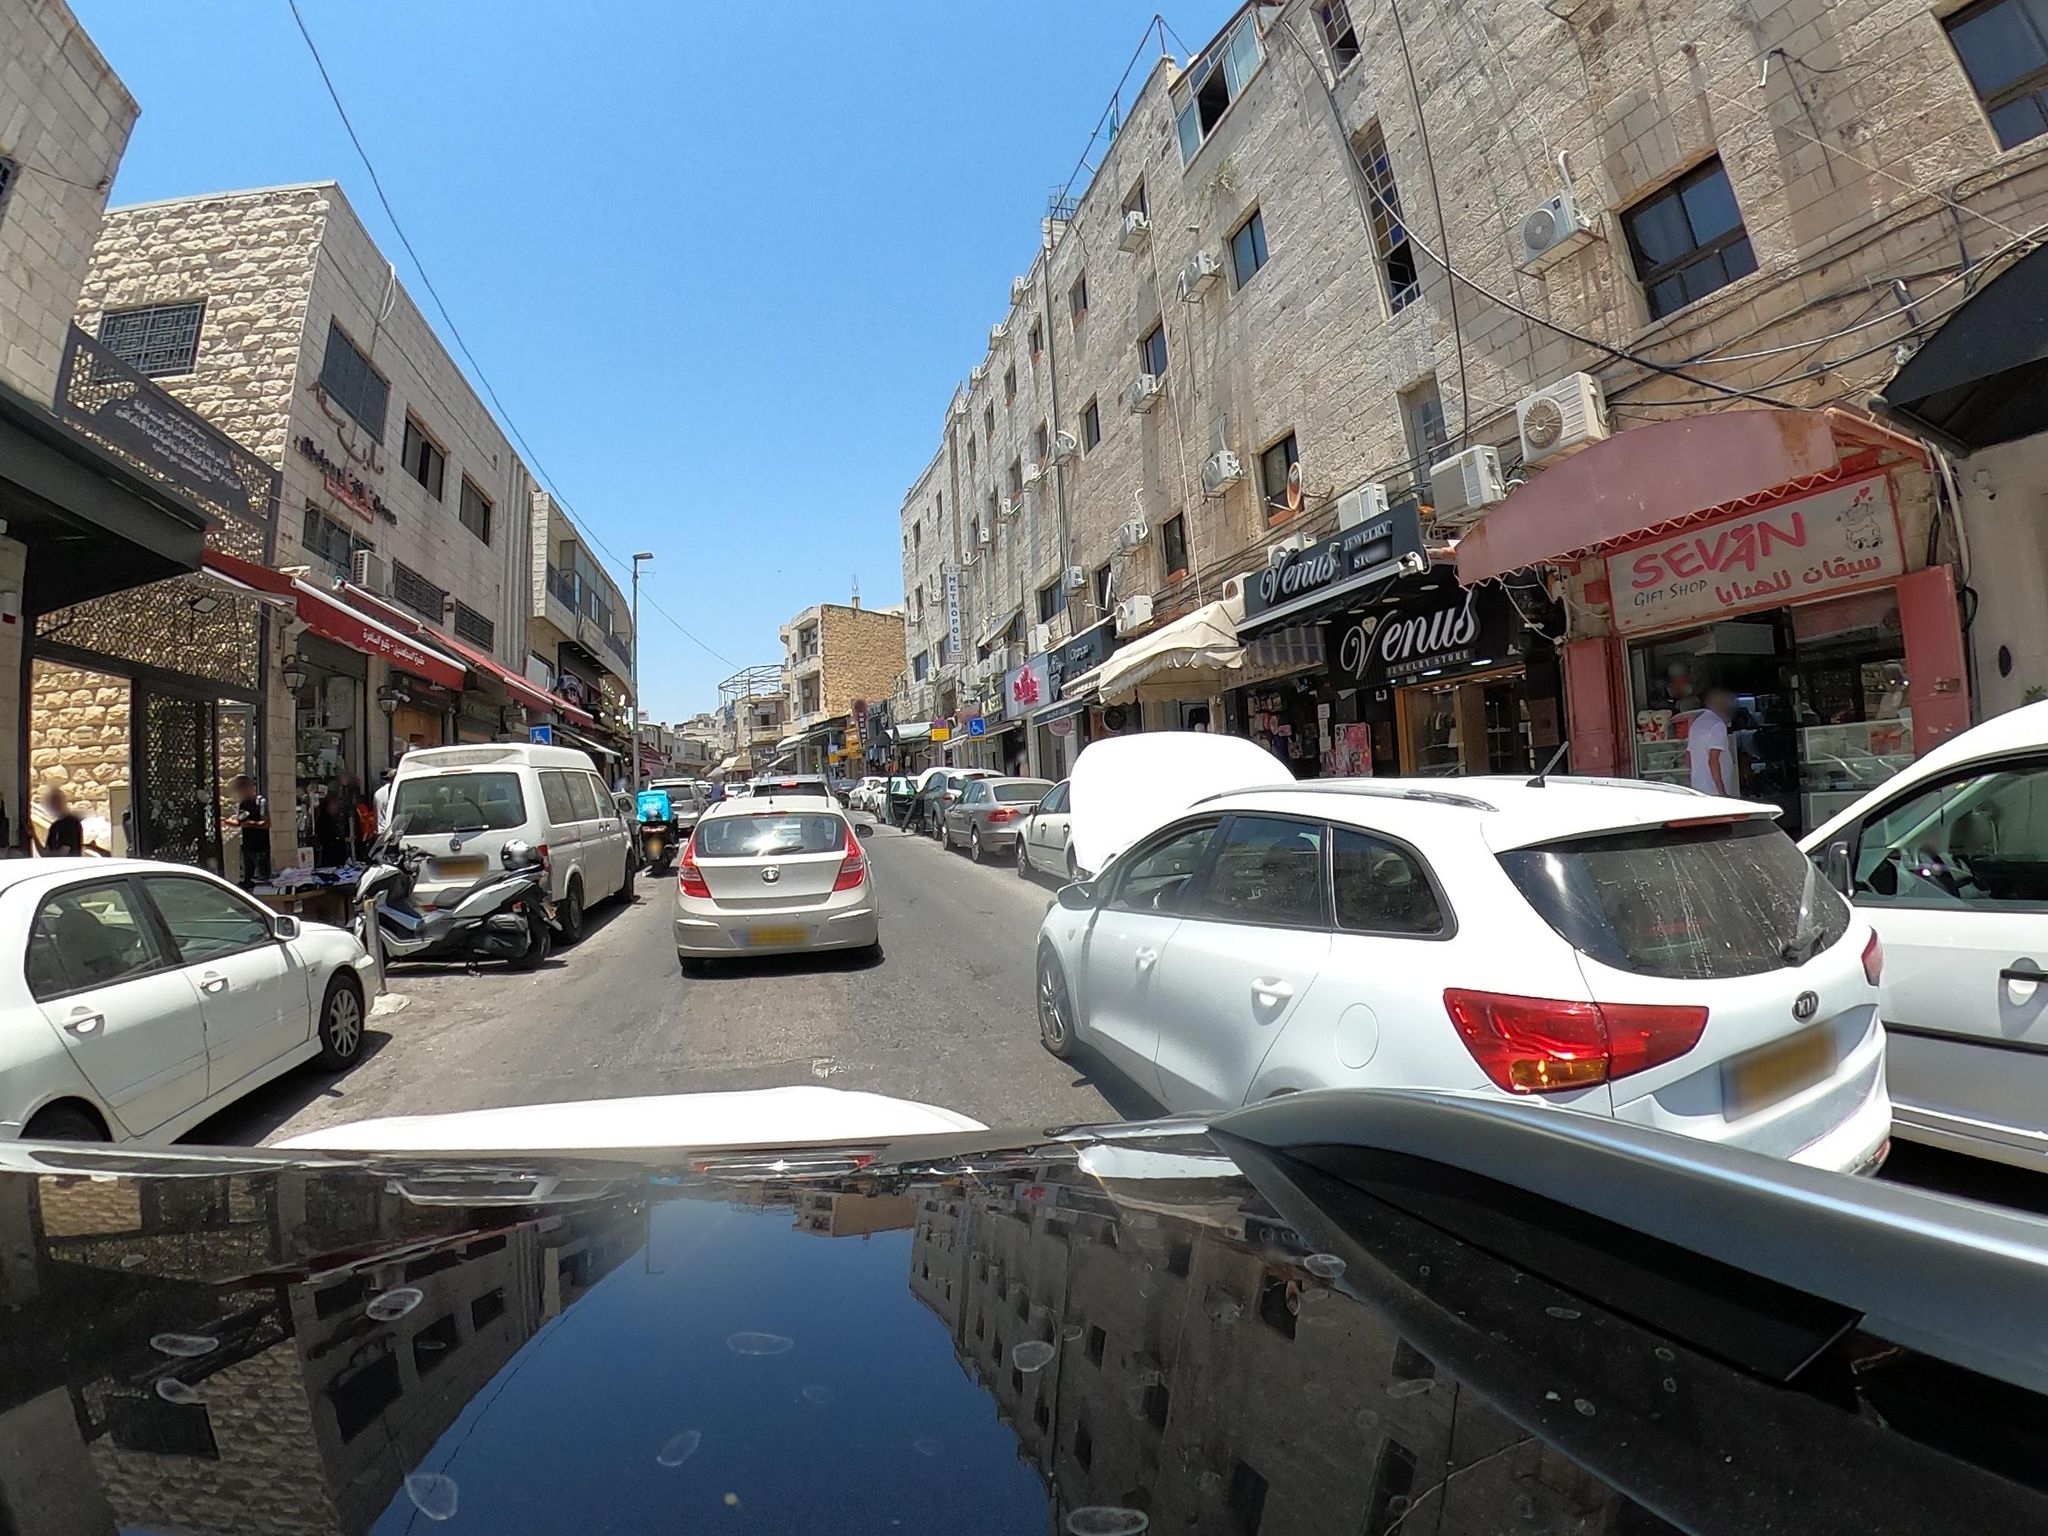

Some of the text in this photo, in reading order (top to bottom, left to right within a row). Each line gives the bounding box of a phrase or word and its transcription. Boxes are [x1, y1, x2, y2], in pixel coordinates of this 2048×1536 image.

[1344, 520, 1392, 551] JEWELRY
[1631, 511, 1808, 589] SEVAN
[1260, 543, 1340, 603] Venus
[1633, 579, 1708, 608] GIFT SHOP
[1715, 570, 1792, 606] للهدايا
[948, 576, 961, 651] METROPOLE
[1340, 591, 1475, 681] Venus
[1387, 650, 1469, 675] JEWELRY STORE
